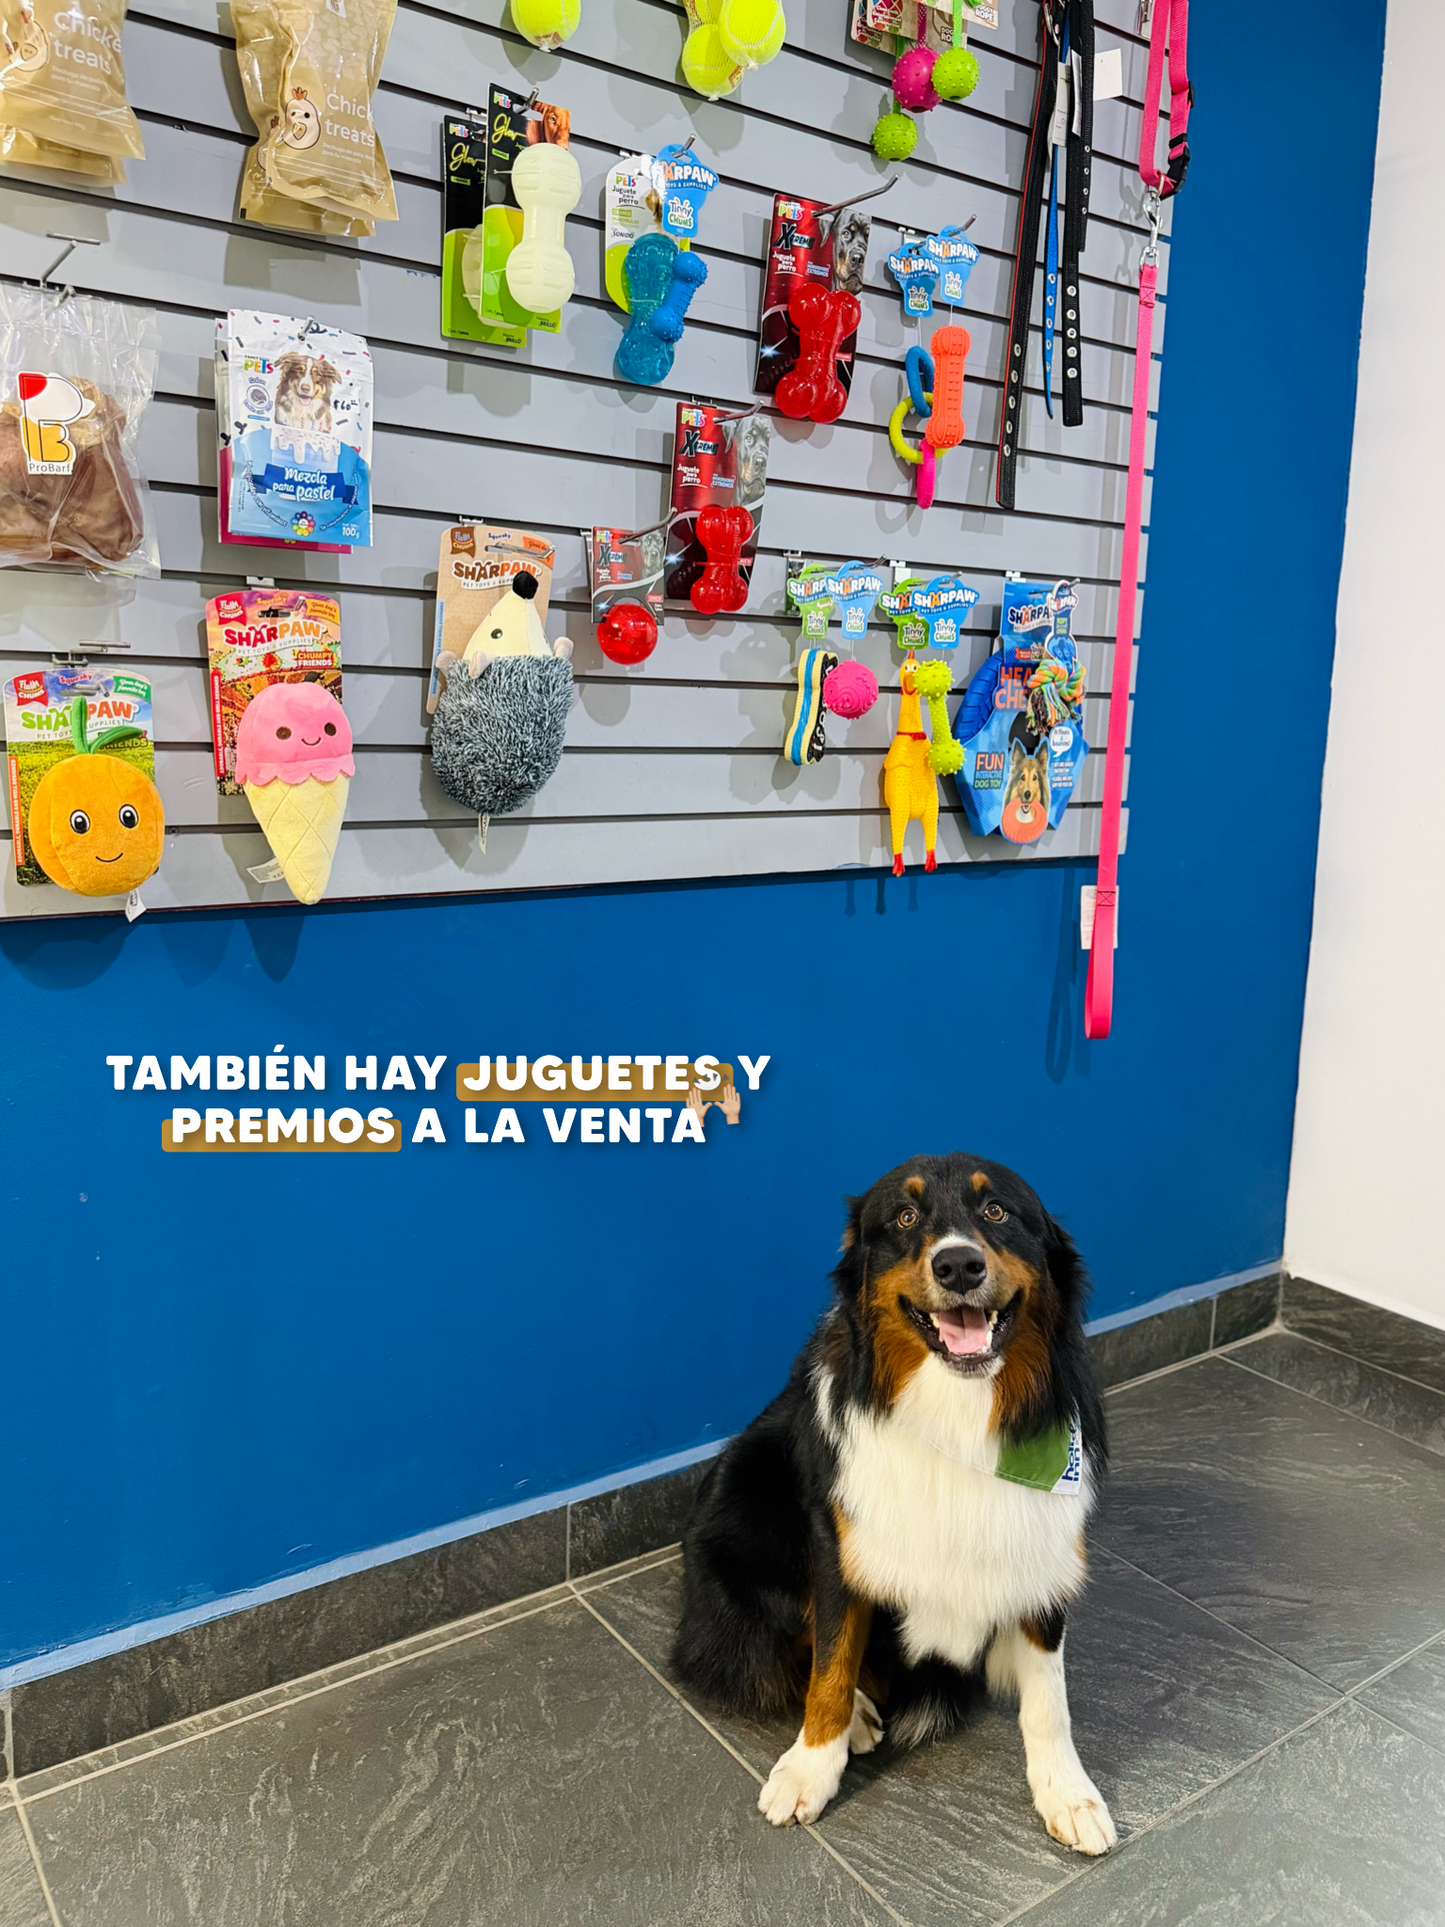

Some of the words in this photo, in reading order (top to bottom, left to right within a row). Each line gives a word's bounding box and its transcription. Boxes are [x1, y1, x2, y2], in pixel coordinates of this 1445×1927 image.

[975, 10, 994, 22] ROPE
[53, 39, 112, 75] treats
[324, 118, 376, 148] treats
[491, 113, 527, 144] Glow
[615, 174, 637, 188] PETS
[611, 185, 637, 197] Juguete
[618, 197, 639, 206] perro
[668, 212, 694, 228] CHUMS
[612, 230, 634, 239] SONIDO
[772, 250, 796, 262] Juguete
[928, 238, 979, 262] SHARPAW
[777, 263, 797, 273] perro
[243, 357, 275, 375] PETS
[28, 462, 72, 473] ProBarf
[284, 466, 328, 486] Mezcla
[676, 463, 700, 475] Juguete
[681, 476, 701, 485] perro
[272, 481, 296, 494] para
[295, 484, 336, 503] pastel
[475, 580, 491, 588] TOYS
[788, 580, 827, 598] SHARP
[827, 576, 881, 596] SHARPAW
[912, 588, 976, 610] SHARPAW
[218, 610, 244, 619] CHUMS
[1008, 604, 1051, 626] SHARPA
[223, 620, 321, 649] SHARPAW
[237, 647, 251, 656] PET
[252, 644, 271, 654] TOYS
[278, 637, 312, 649] SUPPLIES
[296, 651, 333, 661] CHUMPY
[297, 659, 333, 668] FRIENDS
[21, 700, 134, 732] SHAPAW
[36, 732, 52, 740] PET
[53, 729, 73, 739] TOYS
[87, 719, 122, 730] UPPLIES
[975, 753, 1004, 771] FUN
[974, 779, 989, 789] DOG
[989, 779, 1002, 788] TOY
